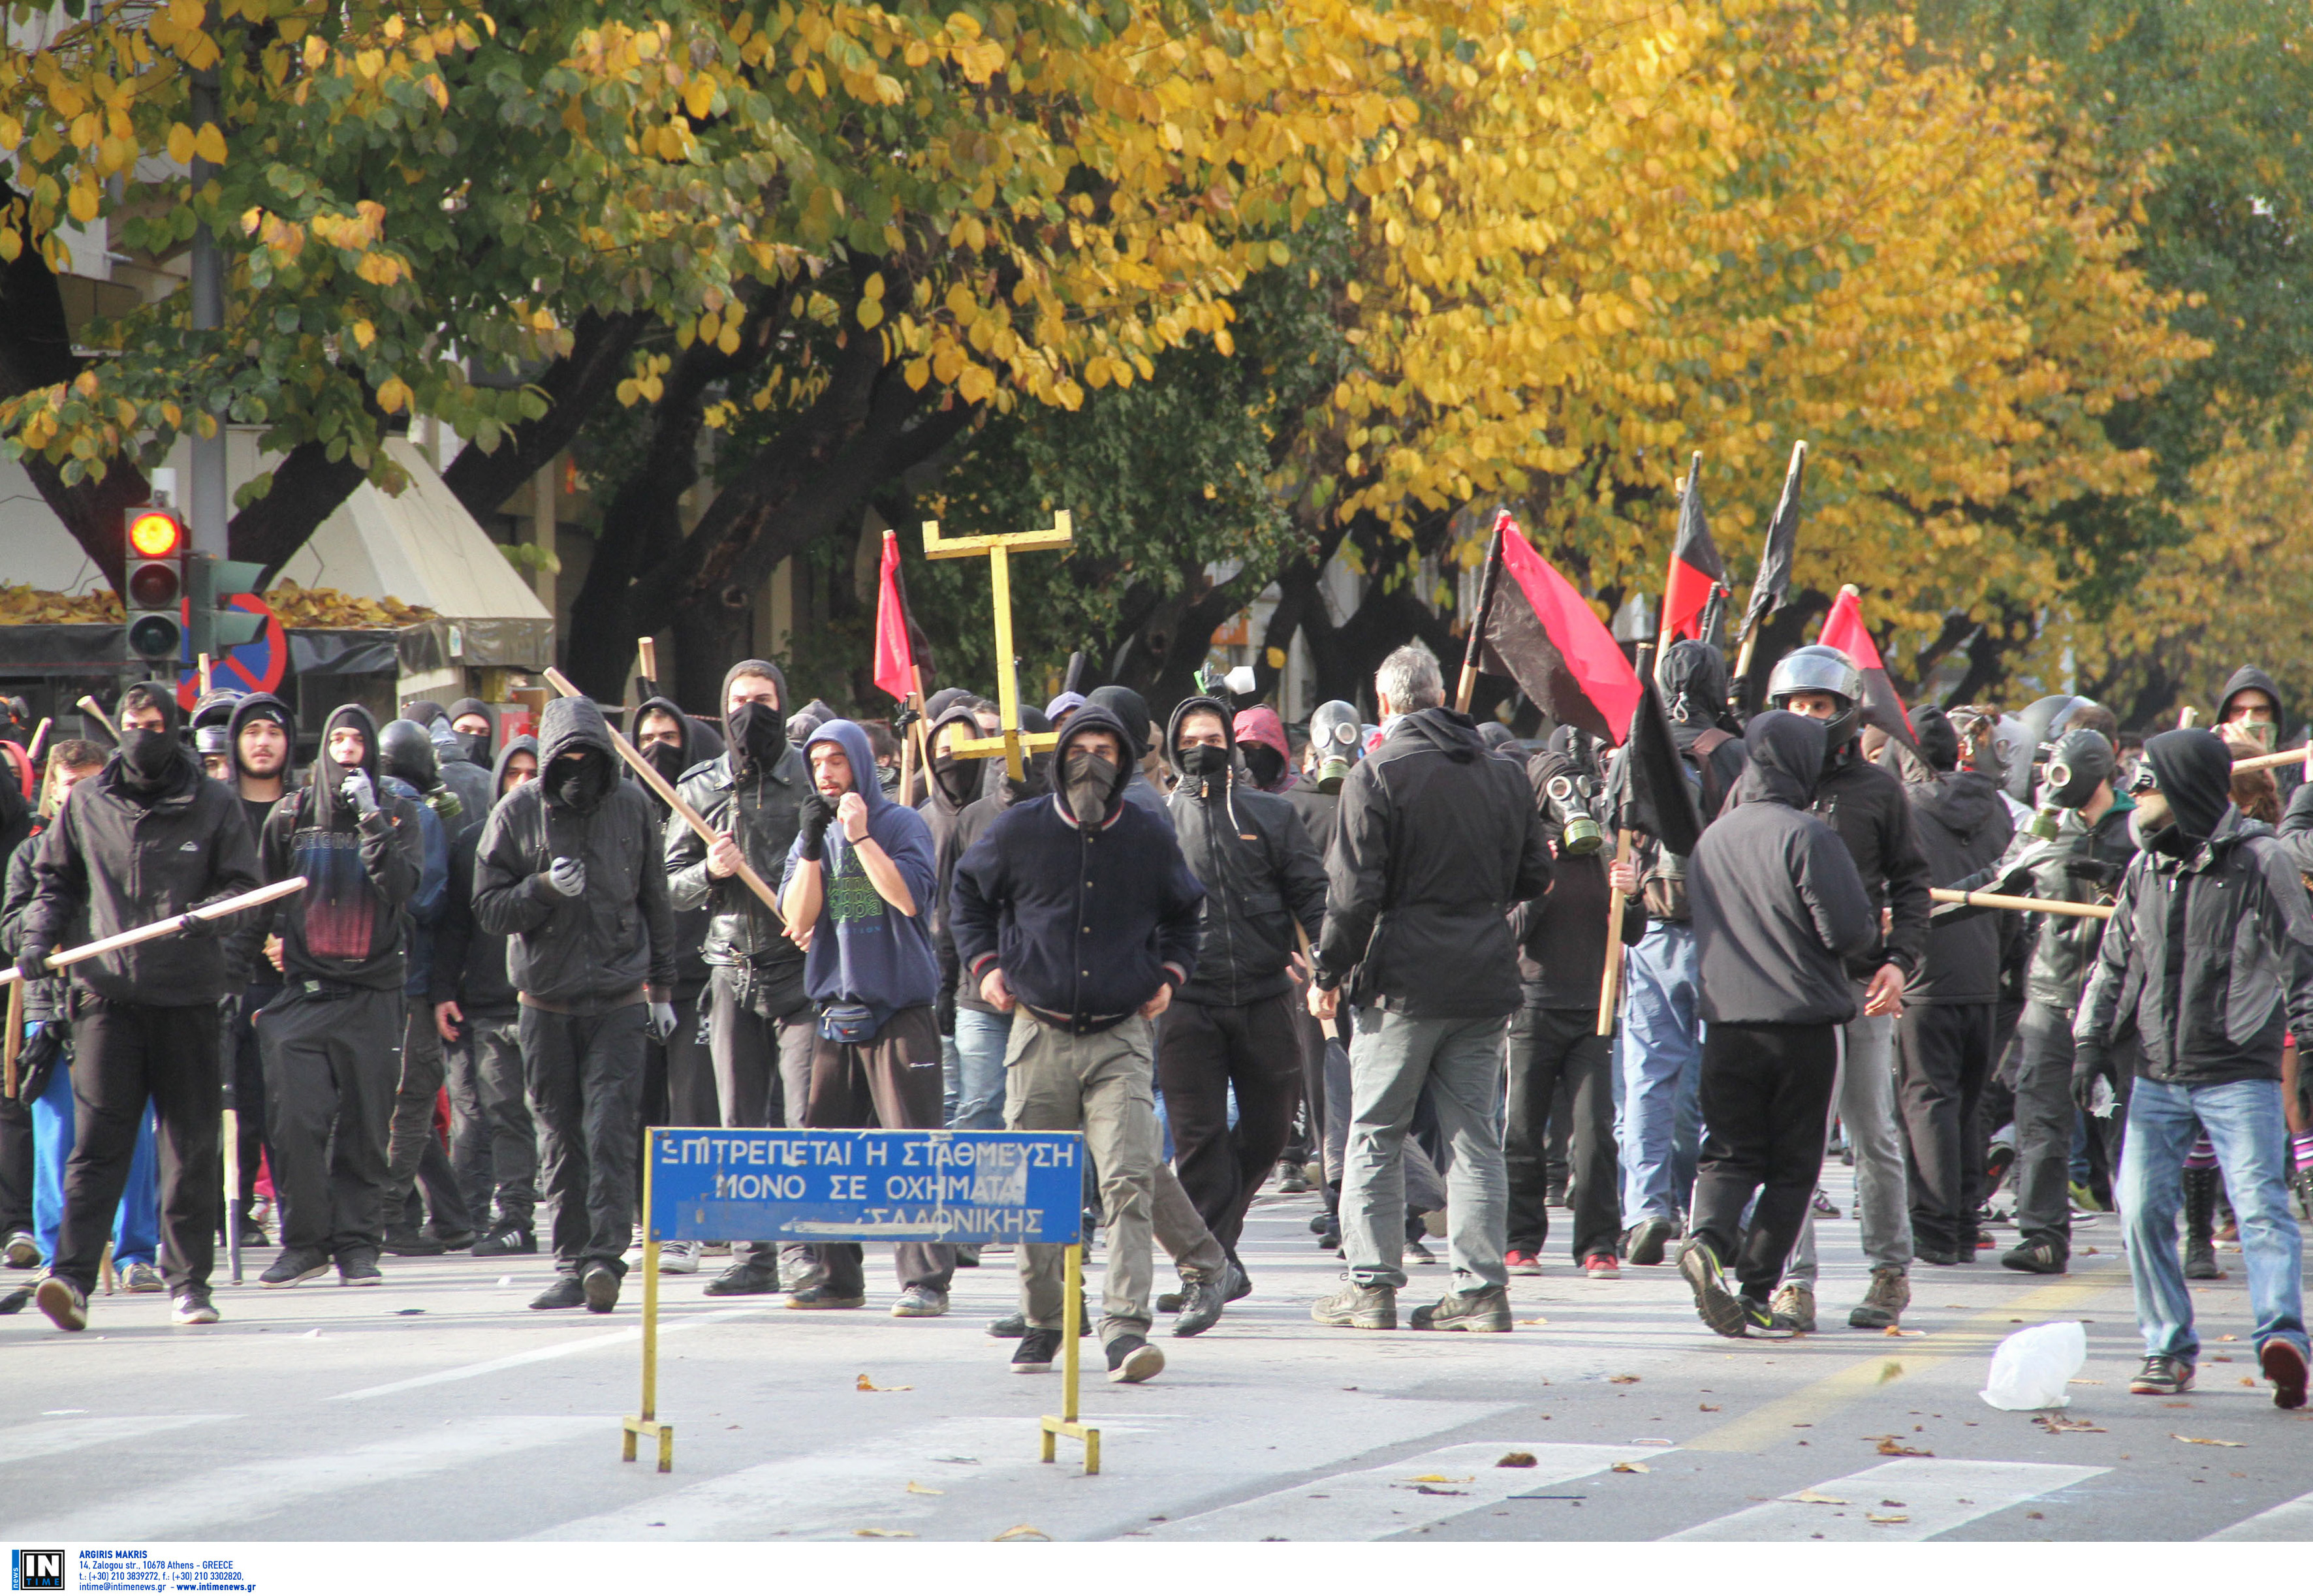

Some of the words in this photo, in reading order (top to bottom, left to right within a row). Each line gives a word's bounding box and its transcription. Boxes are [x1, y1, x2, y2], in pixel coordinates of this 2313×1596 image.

[661, 1138, 852, 1166] ΕΠΙΤΡΕΠΕΤΑΙ
[902, 1142, 1074, 1167] ΣΤΑΘΜΕΥΣΗ
[716, 1174, 806, 1199] ΜΟΝΟ
[830, 1175, 867, 1200] ΣΕ
[886, 1176, 1021, 1201] ΟΧΗΜΑΤΑ
